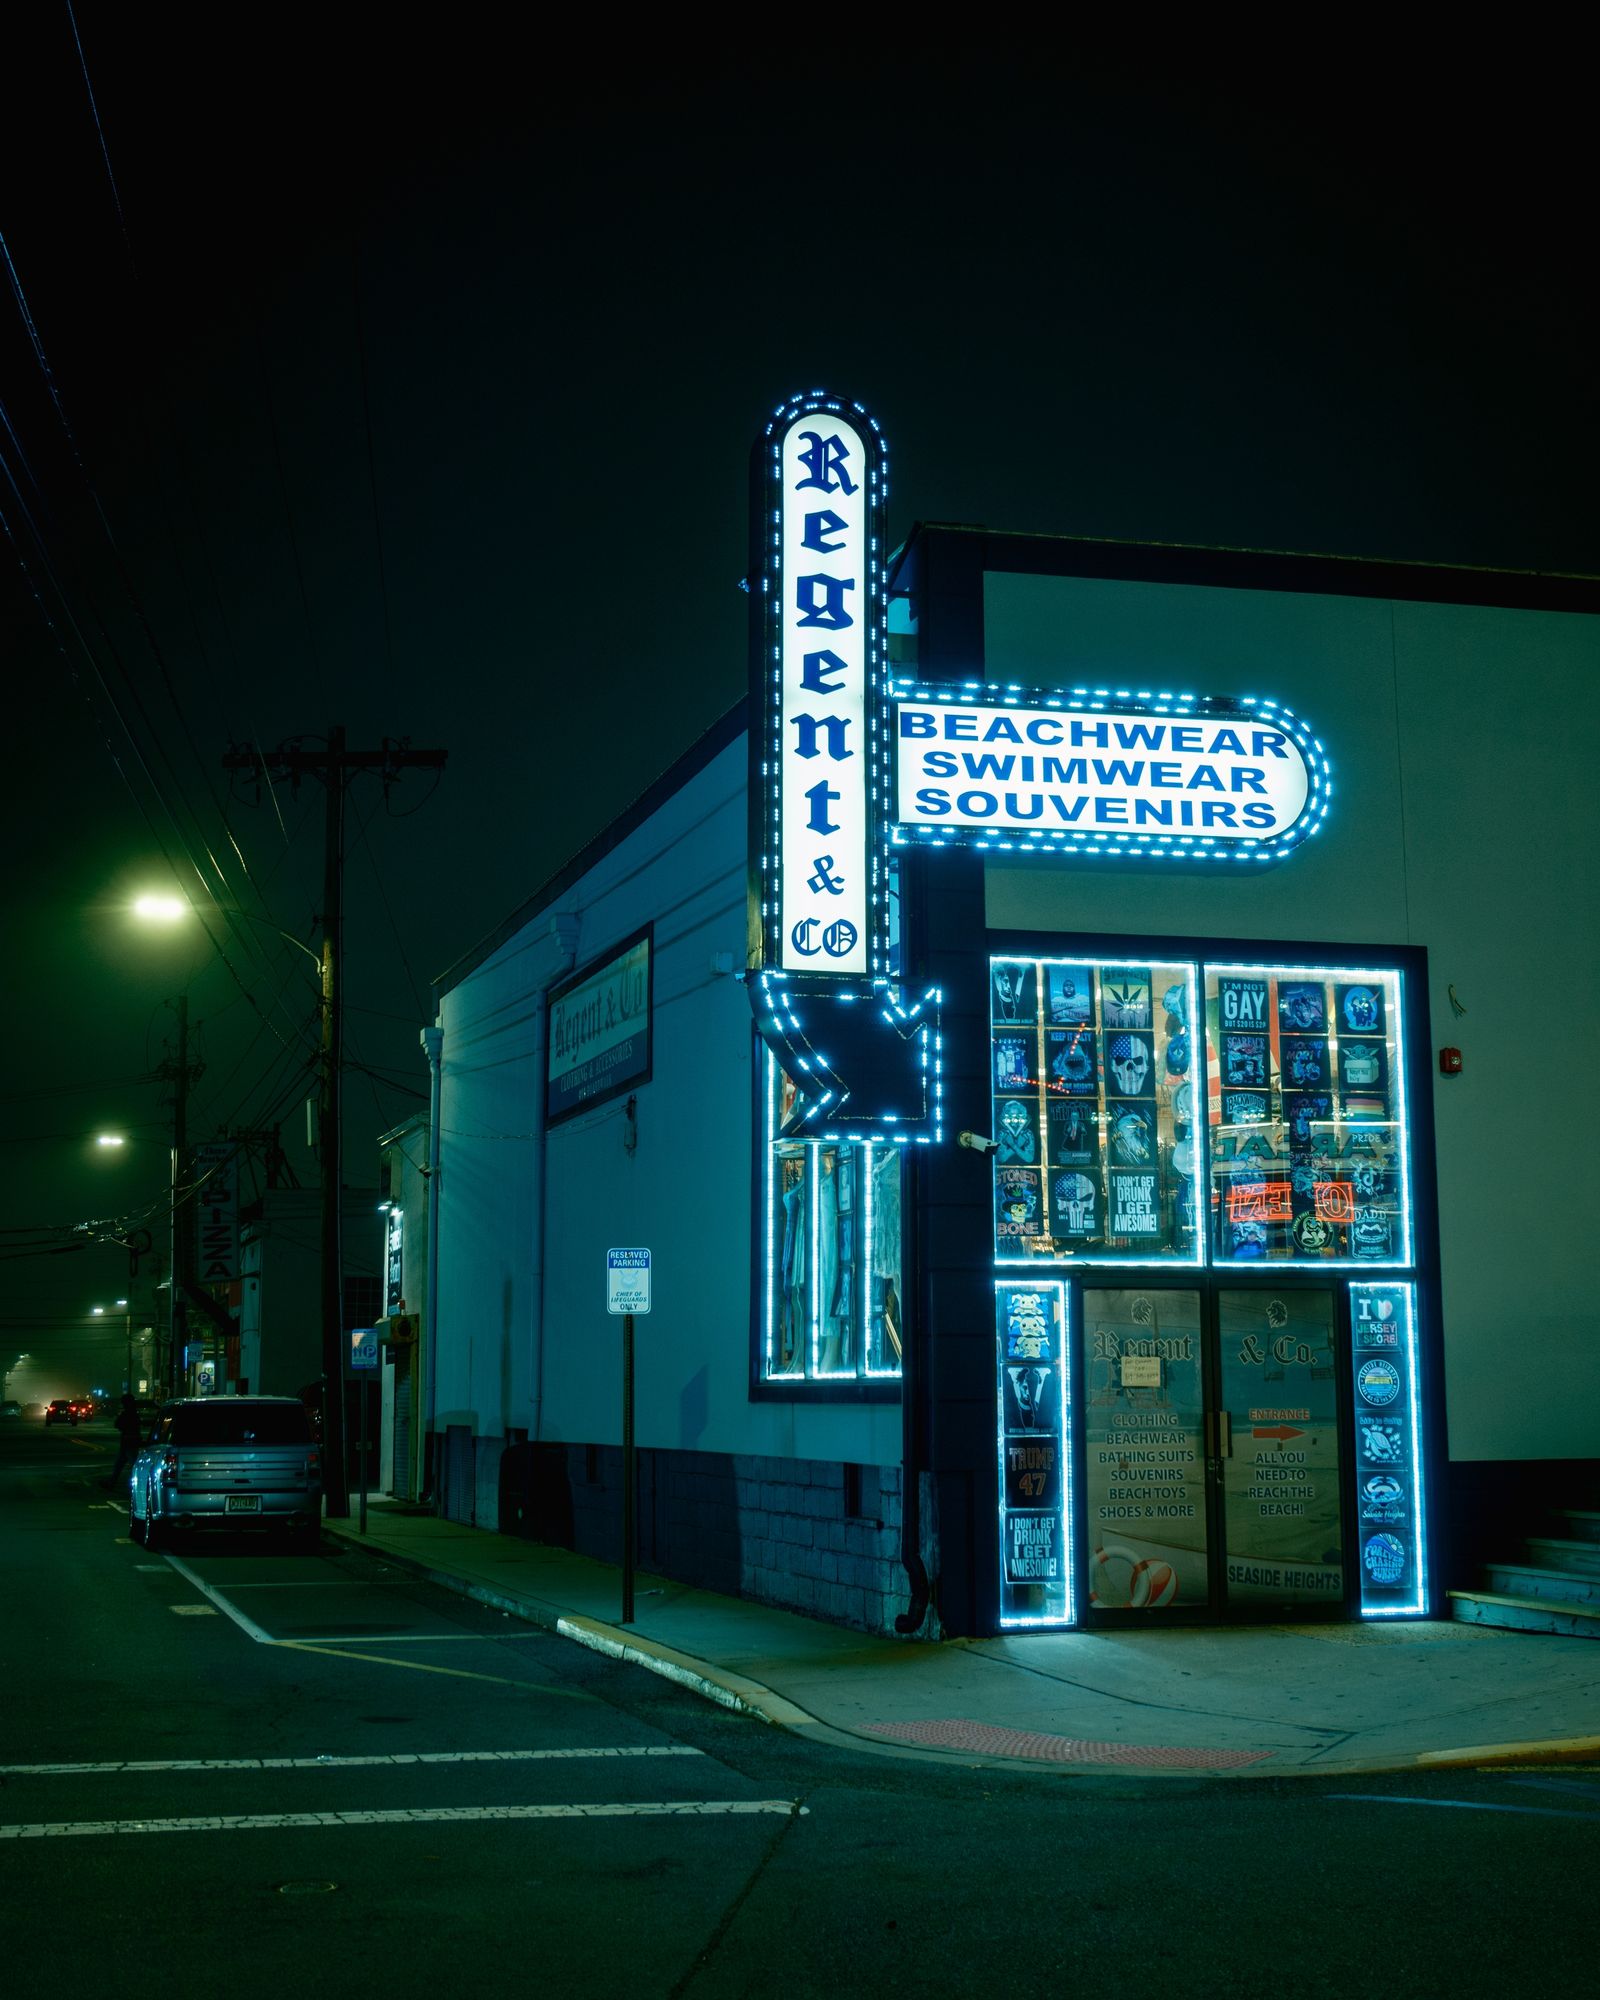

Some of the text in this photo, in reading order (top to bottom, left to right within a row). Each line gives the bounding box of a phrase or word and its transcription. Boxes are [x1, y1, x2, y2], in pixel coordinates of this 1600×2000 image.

[789, 430, 859, 958] Regent & CO
[900, 711, 1289, 759] BEACHWEAR
[922, 750, 1268, 794] SWIMWEAR
[915, 788, 1277, 829] SOUVENIRS
[1243, 983, 1265, 991] NOT
[1224, 990, 1265, 1021] GAY
[555, 989, 602, 1064] Regent
[605, 985, 616, 1029] &
[1352, 1133, 1380, 1143] PRIDE
[995, 1169, 1038, 1186] STONED
[1112, 1176, 1155, 1187] I DON'T GET
[1117, 1186, 1152, 1202] DRUNK
[1117, 1202, 1152, 1214] I GET
[997, 1221, 1039, 1235] BONE
[1114, 1213, 1157, 1232] AWESOME!
[201, 1187, 233, 1278] PIZZA
[610, 1251, 649, 1259] RESERVED
[613, 1259, 646, 1267] PARKING
[1359, 1299, 1371, 1320] I
[1358, 1323, 1396, 1334] JERSEY
[1363, 1334, 1396, 1344] SHORE
[1239, 1335, 1319, 1366] & Co.
[1112, 1414, 1178, 1426] CLOTHING
[1250, 1409, 1310, 1419] ENTRANCE
[1106, 1432, 1186, 1445] BEACHWEAR
[1009, 1448, 1054, 1471] TRUMP
[1099, 1450, 1194, 1463] BATHING SUITS
[1255, 1453, 1304, 1463] ALL YOU
[1111, 1469, 1184, 1481] SOUVENIRS
[1256, 1470, 1306, 1480] NEED TO
[1018, 1472, 1047, 1496] 47
[1109, 1487, 1186, 1499] BEACH TOYS
[1249, 1487, 1313, 1498] REACH THE
[1099, 1505, 1194, 1518] SHOES & MORE
[1260, 1504, 1303, 1515] BEACH!
[1009, 1517, 1055, 1530] I DON'T GET
[1014, 1528, 1052, 1545] DRUNK
[1014, 1544, 1052, 1559] I GET
[1011, 1557, 1057, 1577] AWESOME!
[1228, 1565, 1341, 1591] SEASIDE HEIGHTS
